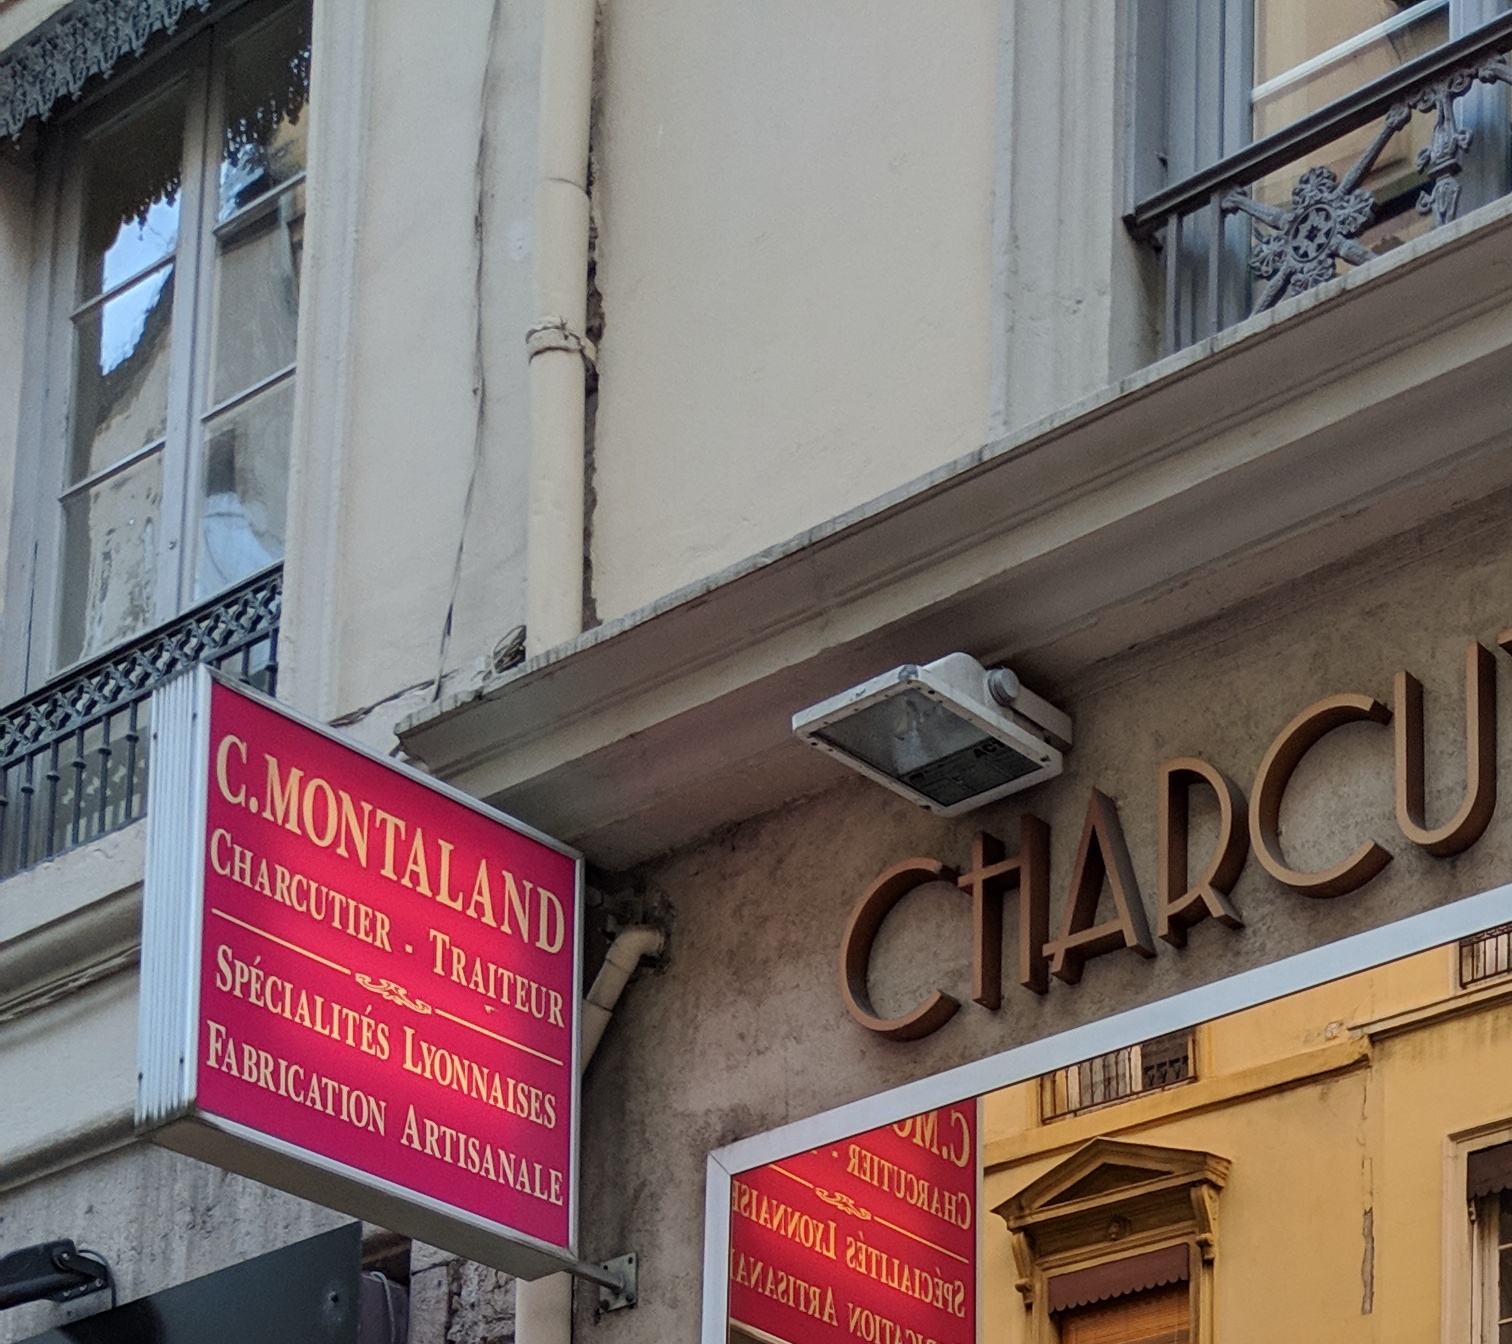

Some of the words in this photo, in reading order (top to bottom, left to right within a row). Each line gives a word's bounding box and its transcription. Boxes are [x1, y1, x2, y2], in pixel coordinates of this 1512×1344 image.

[210, 827, 393, 952] CHARCUTIER
[429, 928, 565, 1030] TRAITEUR
[206, 1020, 387, 1137] FABRICATION
[400, 1103, 564, 1206] ARTISANALE
[216, 944, 390, 1060] SPÉCIALITÉS
[403, 1026, 557, 1130] LYONNAISES
